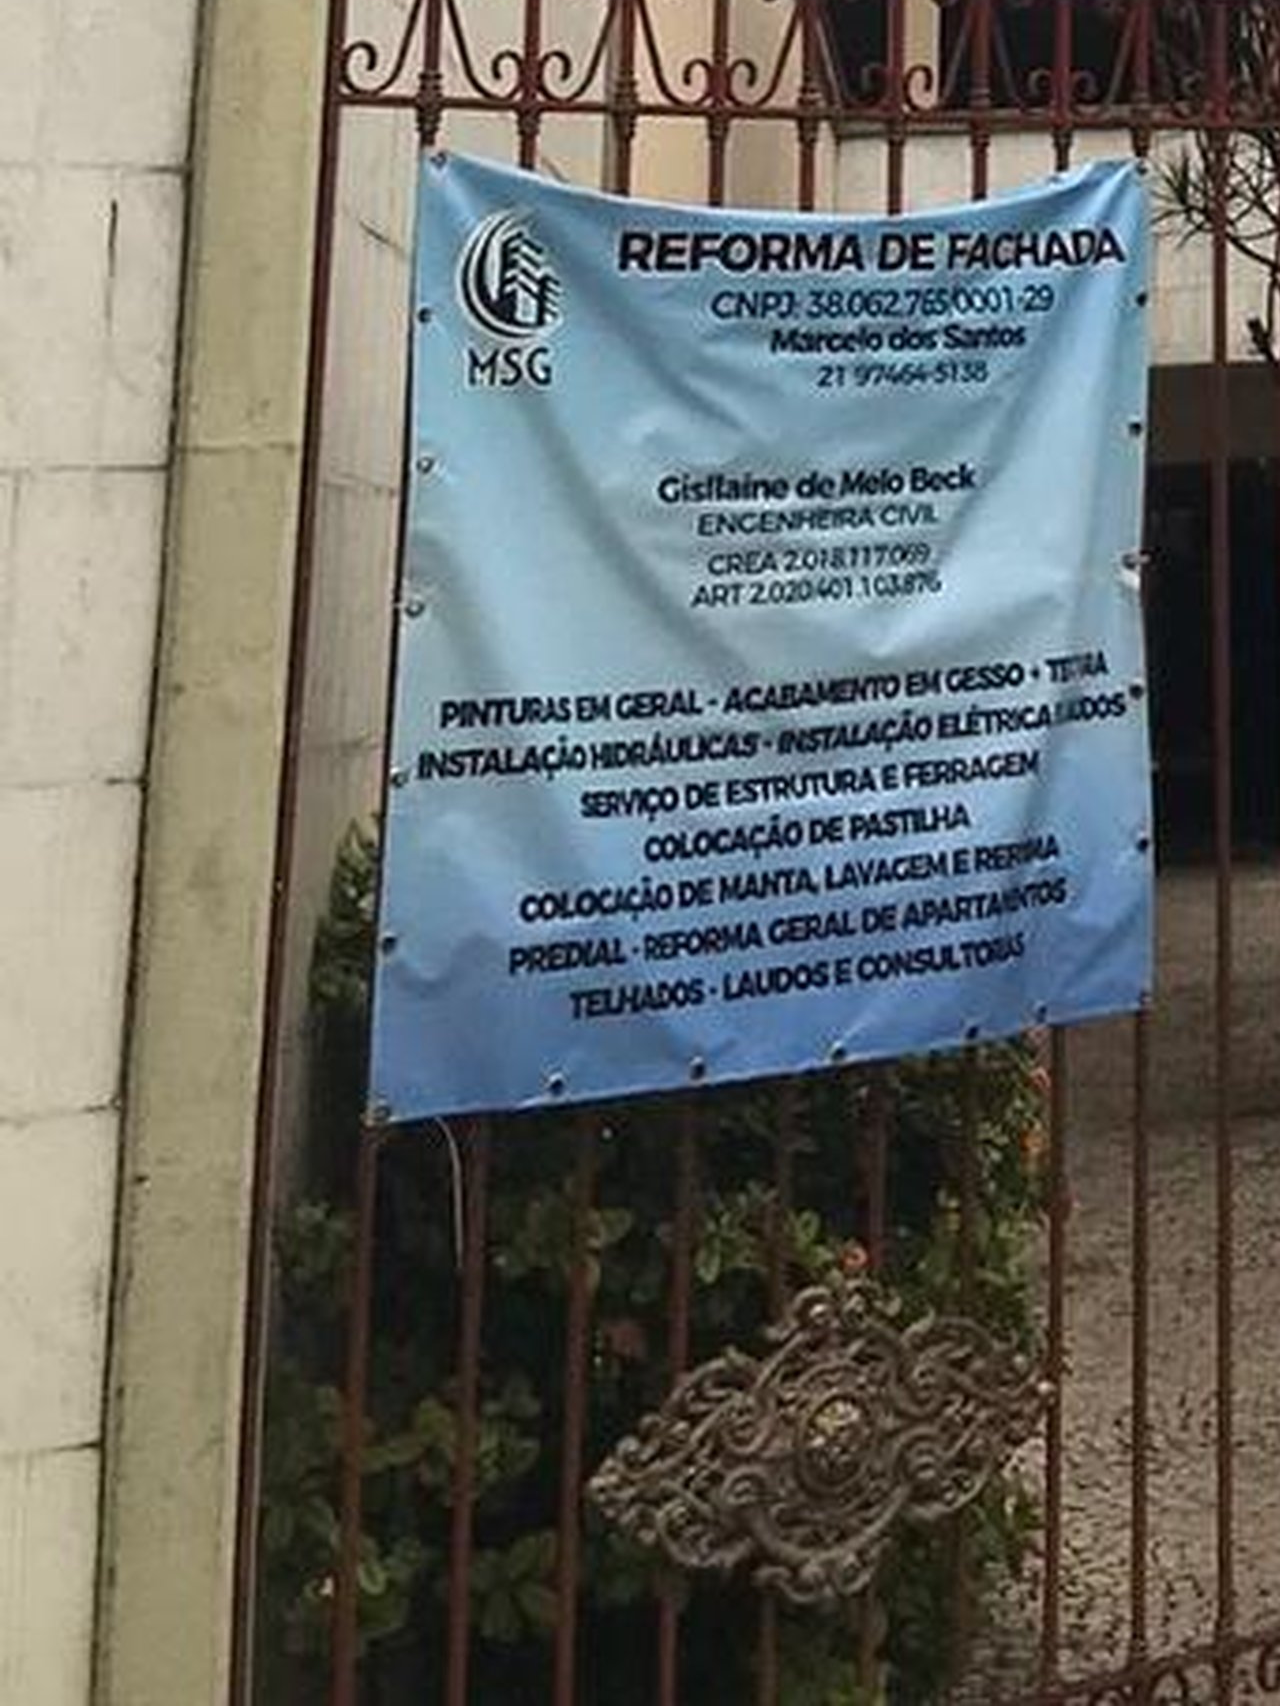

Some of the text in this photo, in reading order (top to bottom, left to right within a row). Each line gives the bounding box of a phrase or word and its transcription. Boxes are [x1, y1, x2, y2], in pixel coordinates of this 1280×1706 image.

[618, 228, 1126, 273] REFORMA DE FACHADA
[770, 323, 1026, 354] Marcelo dos Santos
[468, 347, 552, 387] MSG
[796, 471, 835, 500] de
[840, 467, 904, 498] Melo
[910, 463, 976, 493] Beck
[698, 508, 874, 536] ENGENHEIRA
[707, 551, 778, 576] CREA
[691, 584, 747, 608] ART
[440, 696, 572, 729] PINTURAS
[576, 694, 610, 722] EM
[615, 689, 702, 720] GERAL
[723, 674, 899, 713] ACABAMENTO
[905, 671, 941, 703] EM
[946, 662, 1025, 694] GESSO
[581, 751, 1040, 823] SERVIÇO DE ESTRUTURA E FERRAGEM
[809, 816, 844, 844] DE
[850, 803, 970, 840] PASTILHA
[679, 878, 714, 908] DE
[825, 849, 946, 890] LAVAGEM
[953, 848, 970, 876] E
[509, 937, 628, 975] PREDIAL
[644, 922, 765, 961] REFORMA
[769, 910, 856, 945] GERAL
[862, 905, 897, 935] DE
[569, 978, 705, 1019] TELHADOS
[724, 961, 829, 1000] LAUDOS
[835, 958, 853, 985] E
